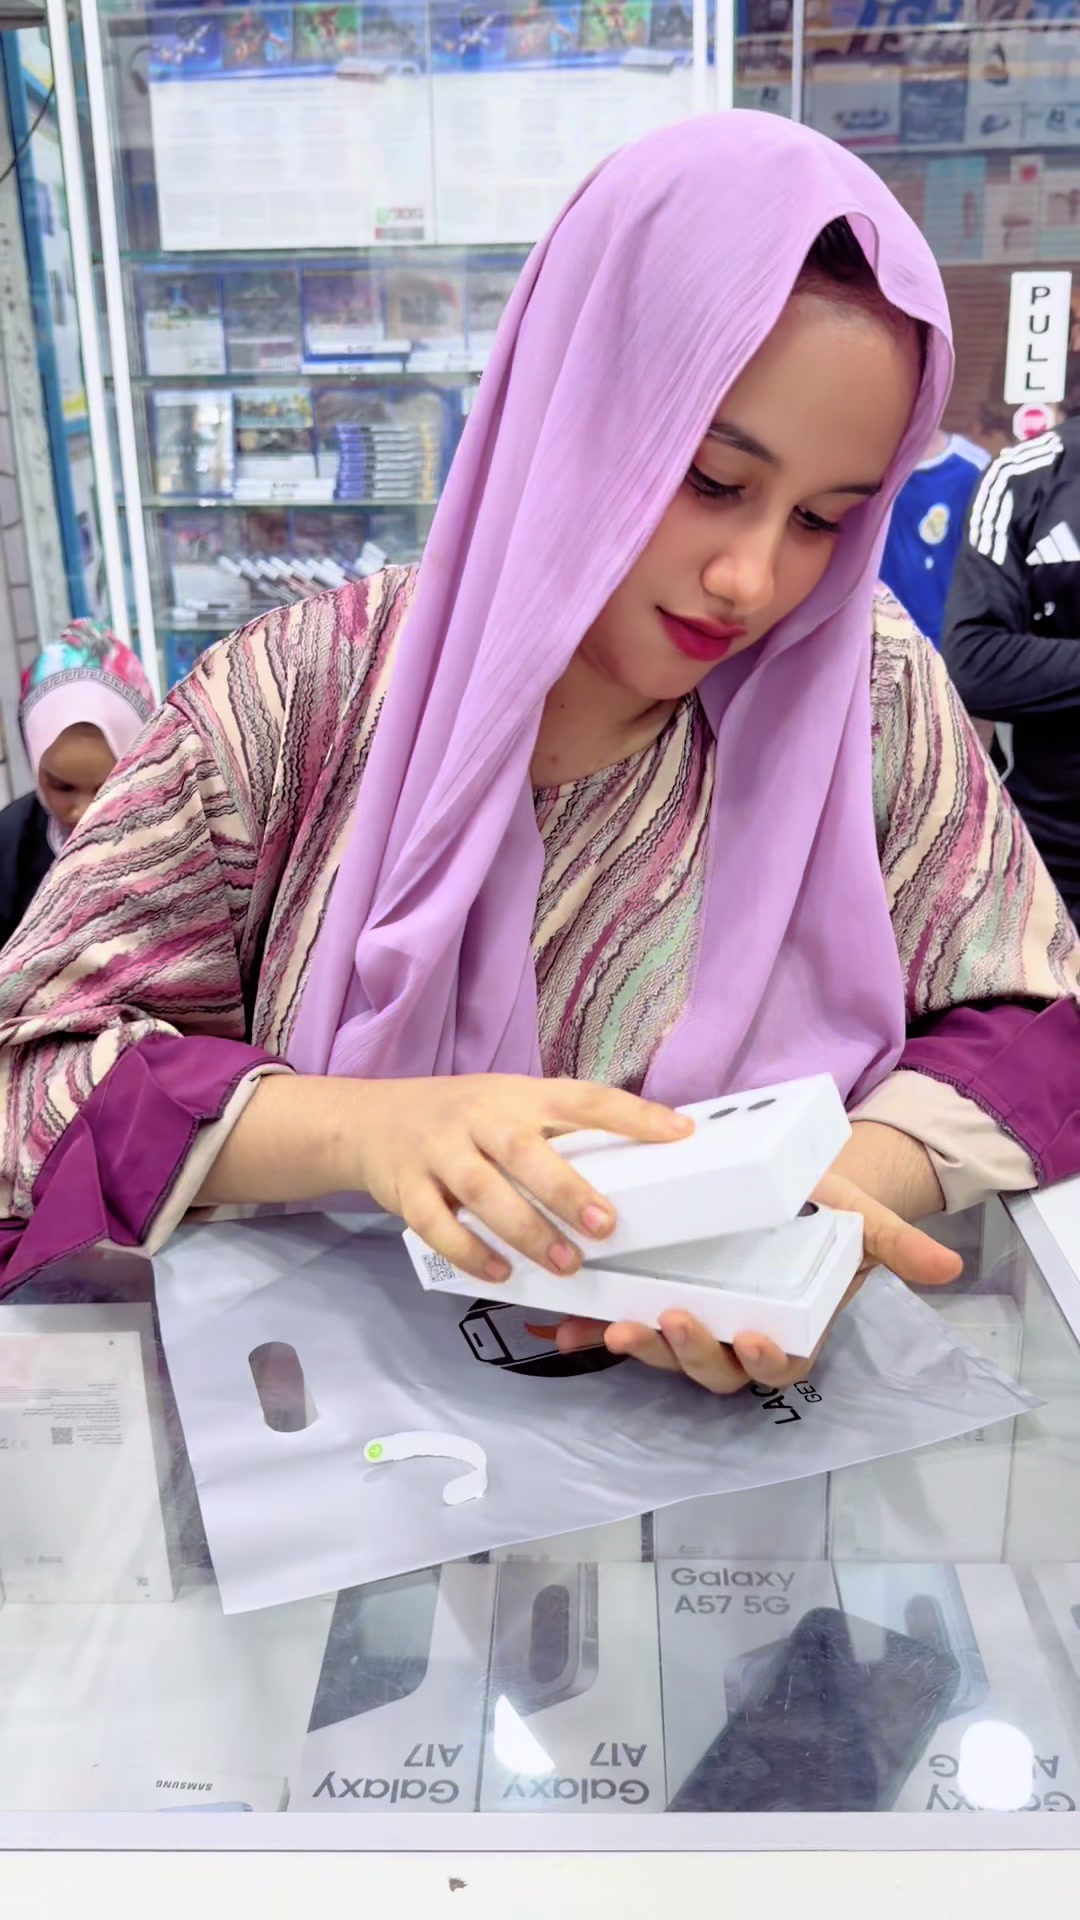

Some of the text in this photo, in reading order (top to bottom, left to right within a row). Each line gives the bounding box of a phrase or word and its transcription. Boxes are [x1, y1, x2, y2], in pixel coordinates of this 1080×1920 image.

[1025, 286, 1051, 390] PULL
[671, 1567, 796, 1592] Galaxy
[673, 1594, 791, 1615] A57 5G
[404, 1743, 464, 1767] A17
[590, 1742, 647, 1767] A17
[155, 1779, 213, 1791] SAMSUNG
[312, 1770, 460, 1804] Galaxy
[502, 1773, 650, 1805] Galaxy
